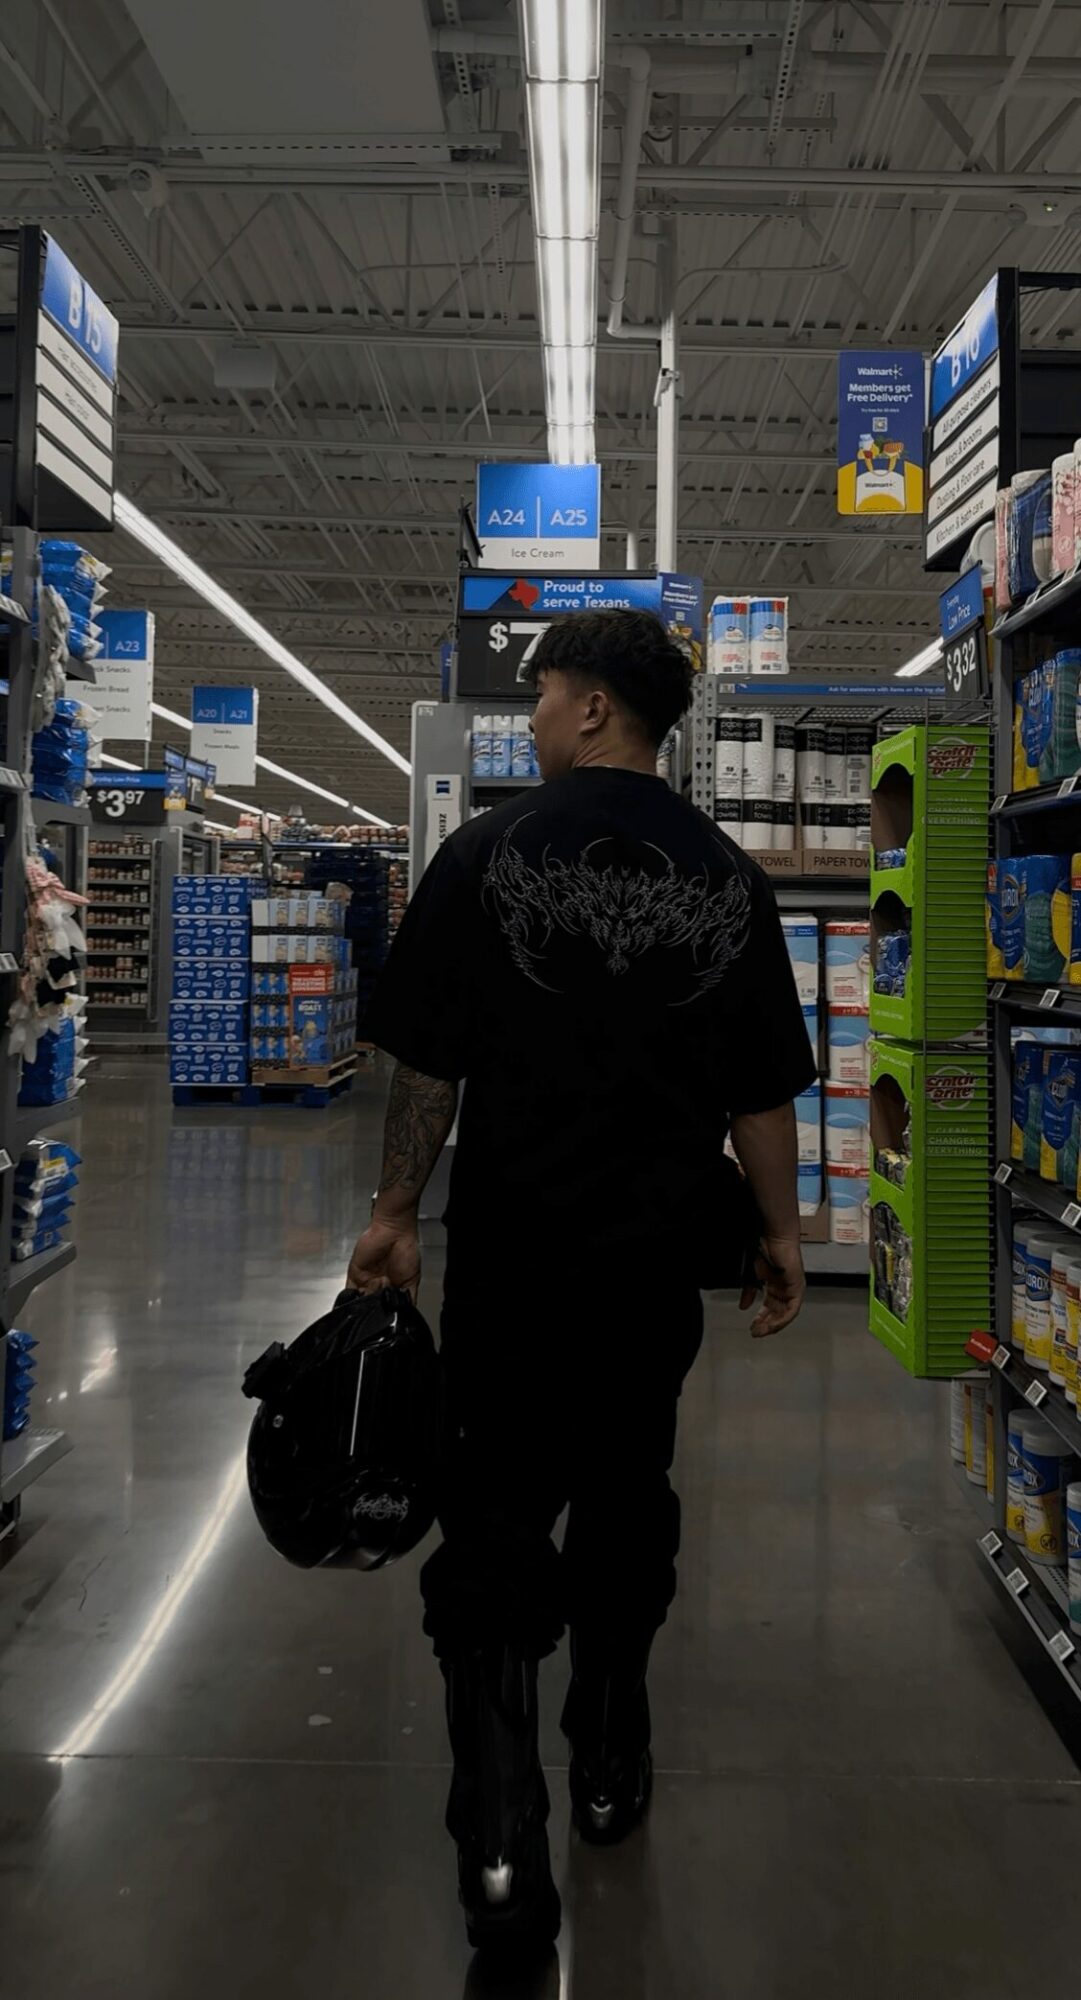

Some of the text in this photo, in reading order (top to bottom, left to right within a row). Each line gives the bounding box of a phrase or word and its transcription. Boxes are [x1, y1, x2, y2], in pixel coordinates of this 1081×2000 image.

[857, 367, 893, 376] Walmart
[849, 383, 912, 394] Members get
[847, 393, 869, 402] Free
[945, 450, 957, 470] Mops
[963, 426, 983, 450] brooms
[972, 460, 985, 477] care
[487, 509, 589, 526] A24 A25
[935, 523, 955, 545] Kitchen
[960, 507, 972, 526] bath
[972, 499, 985, 517] care
[511, 548, 565, 558] Ice Cream
[543, 580, 604, 593] Proud to
[543, 595, 630, 609] serve Texans
[948, 604, 971, 631] Low Price
[114, 640, 140, 653] A23
[106, 666, 131, 674] Snacks
[83, 685, 130, 693] Frozen Bread
[106, 705, 131, 713] Snacks
[196, 708, 249, 719] A20 A21
[438, 813, 447, 840] ZEISS
[759, 855, 797, 867] TOWEL
[813, 855, 847, 867] PAPER
[928, 1137, 977, 1145] CHANGES
[927, 1146, 984, 1156] VERYTHING
